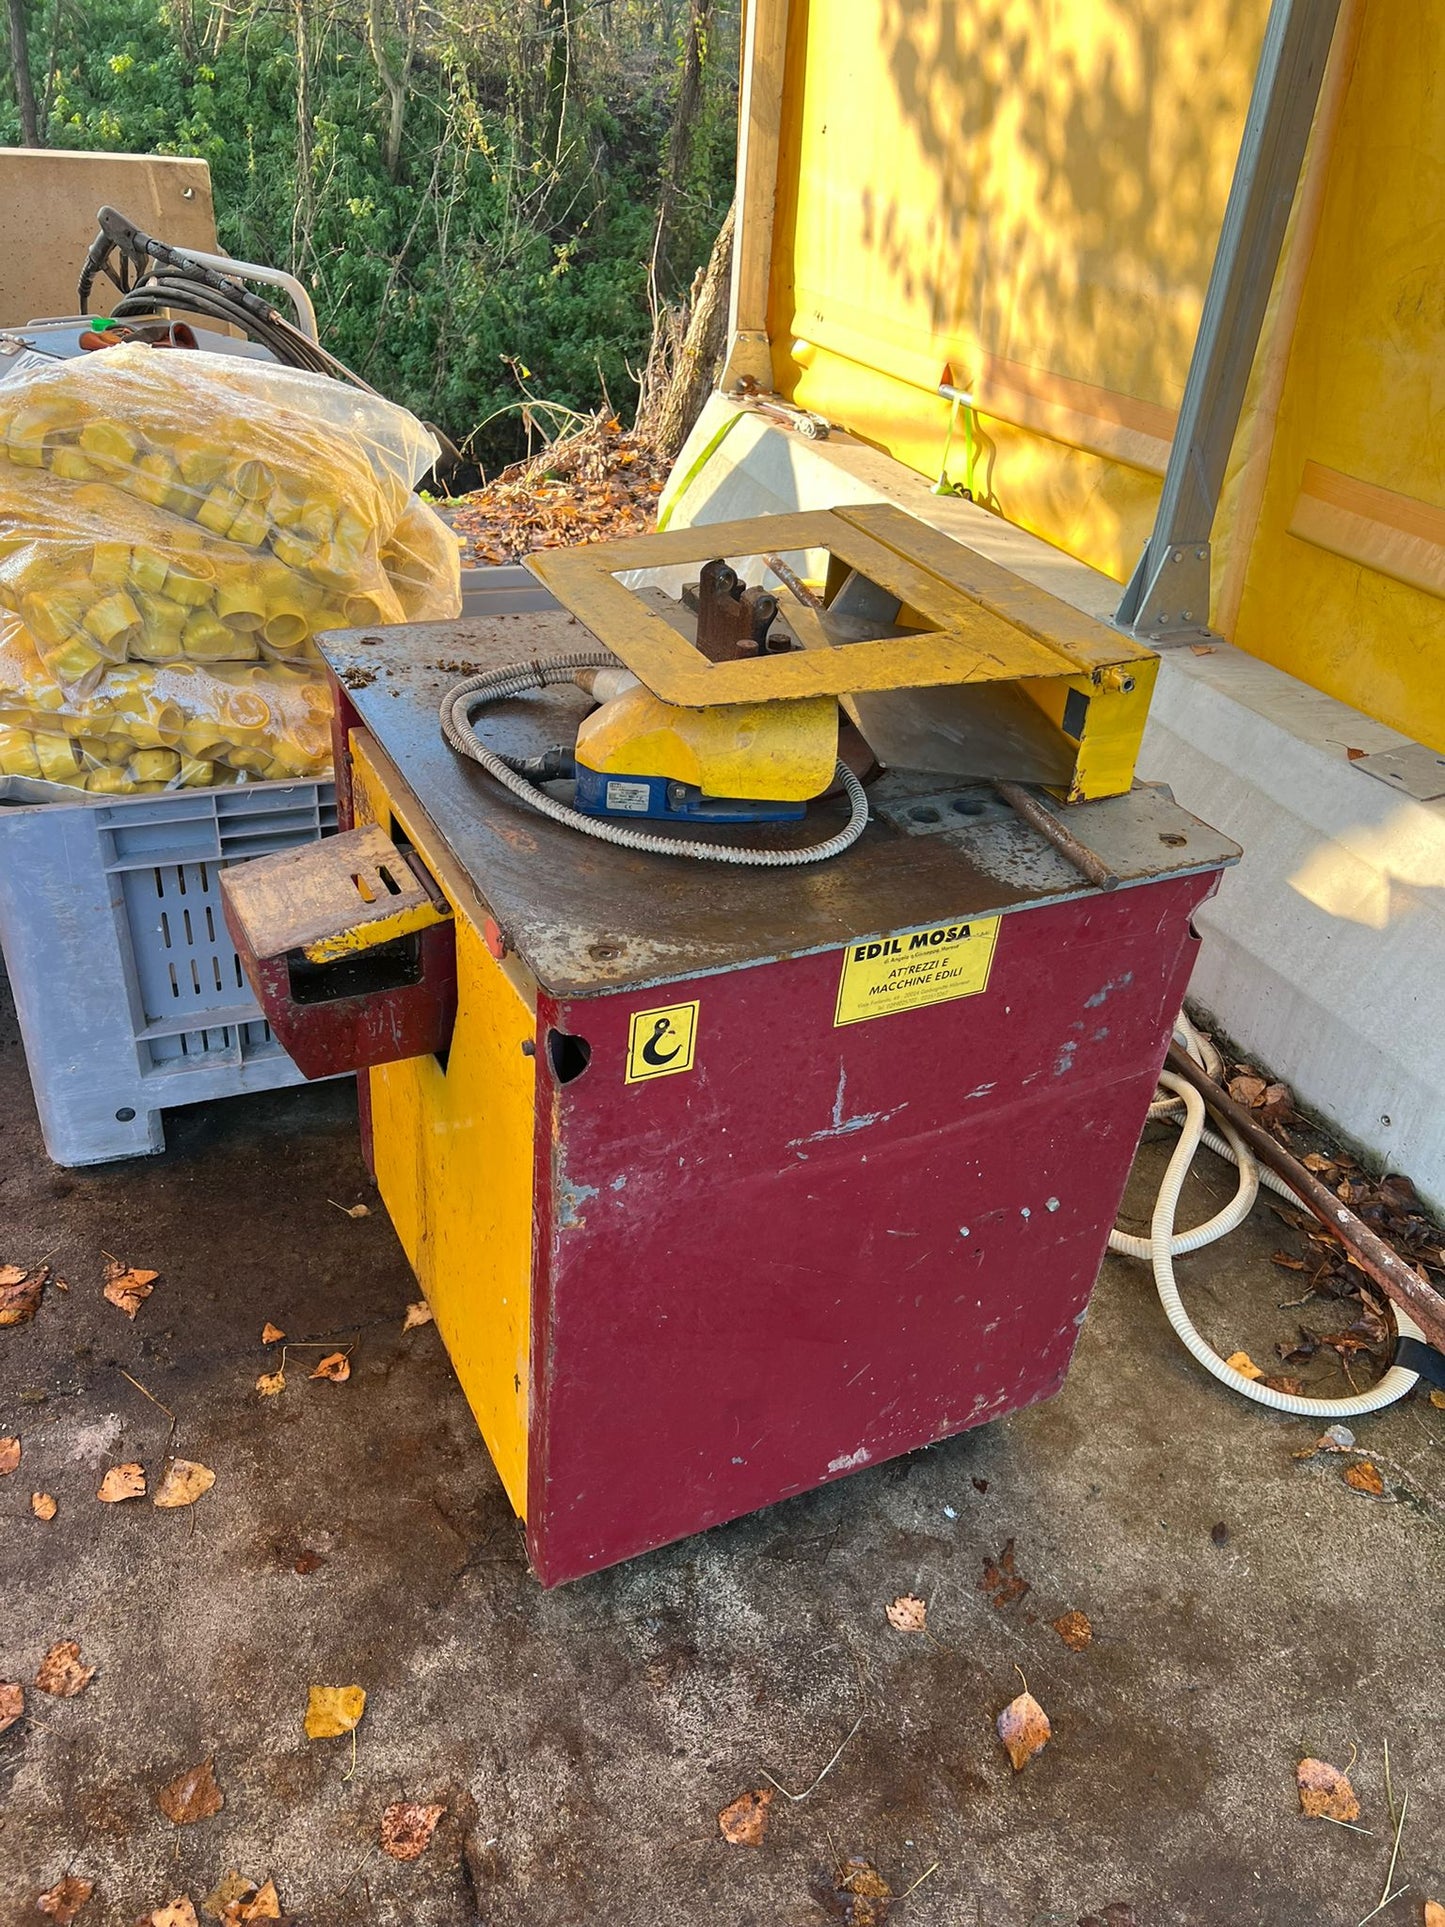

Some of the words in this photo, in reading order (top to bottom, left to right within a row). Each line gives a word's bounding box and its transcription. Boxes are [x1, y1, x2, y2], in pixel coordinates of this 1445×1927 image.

[854, 939, 902, 962] EDIL
[908, 925, 971, 951] MOSA
[942, 957, 949, 967] E
[869, 975, 931, 996] MACCHINE
[934, 967, 963, 981] EDILI
